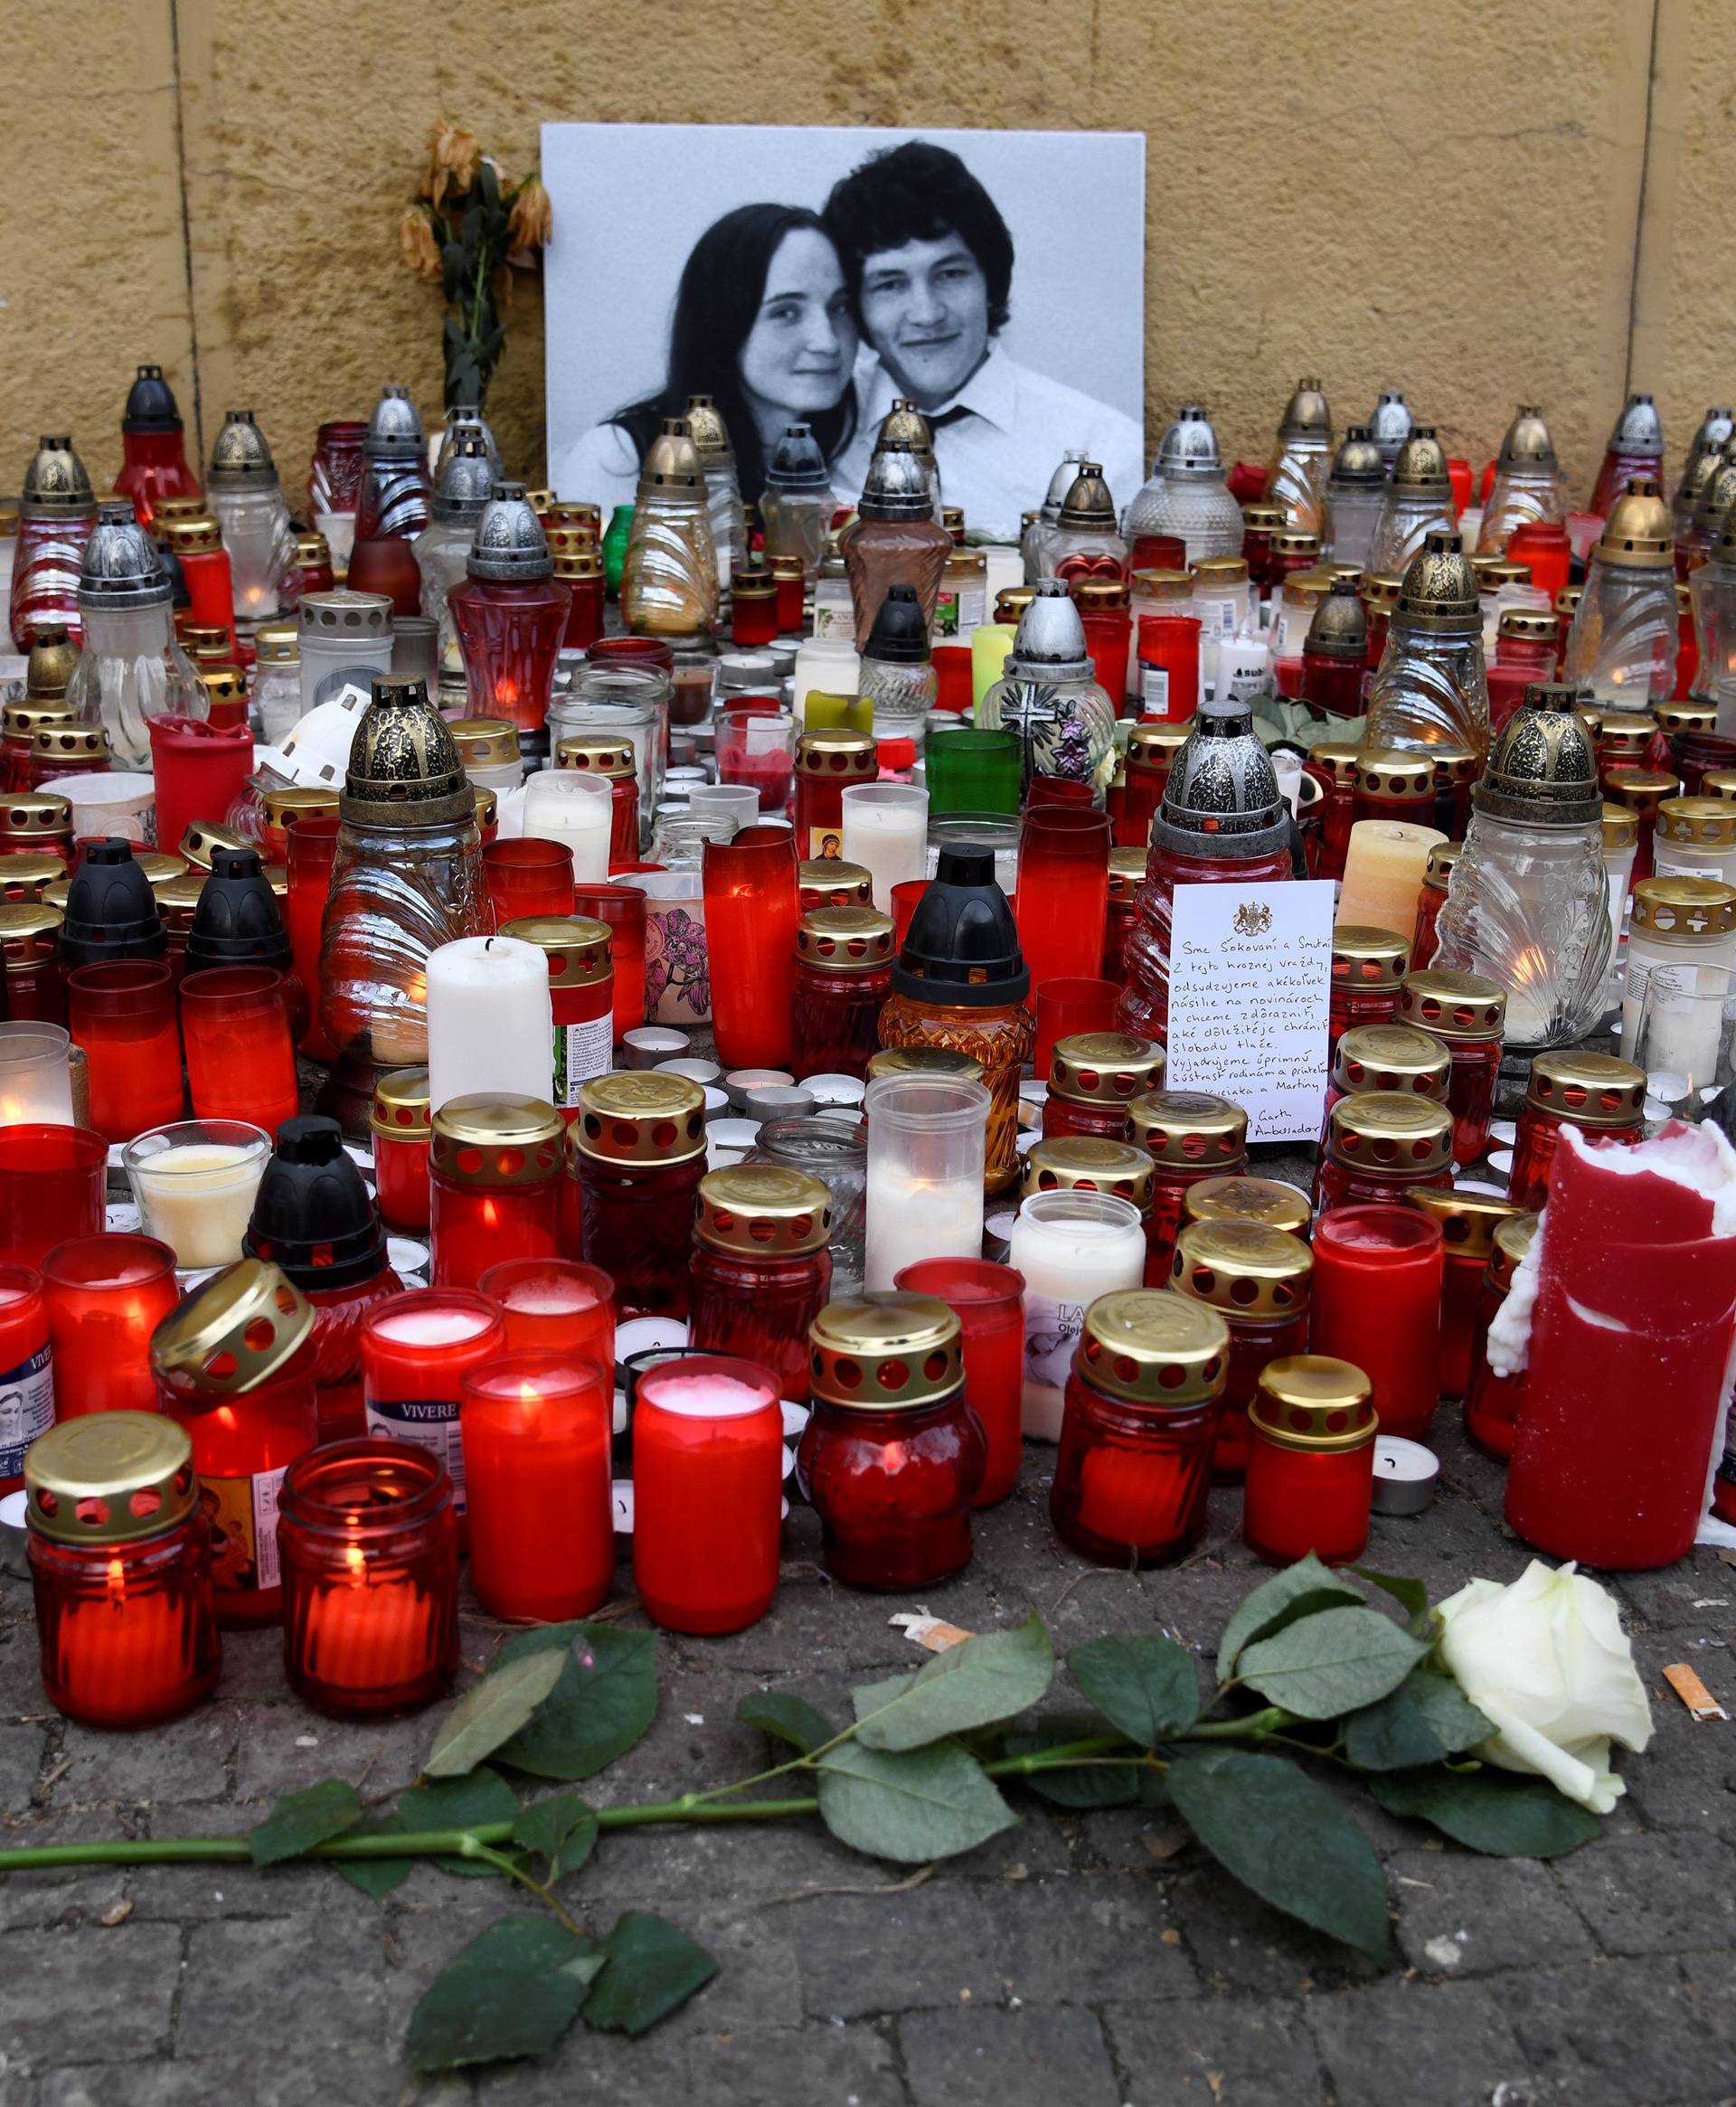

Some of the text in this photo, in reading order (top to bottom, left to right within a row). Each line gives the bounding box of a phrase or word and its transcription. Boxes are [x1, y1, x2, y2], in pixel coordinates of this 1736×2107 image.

[1182, 940, 1211, 955] Sme
[1191, 960, 1219, 975] tejto
[1226, 959, 1273, 973] hroznej
[1171, 996, 1219, 1009] násilie
[1186, 1013, 1231, 1023] chceme
[1172, 1026, 1196, 1039] aké
[1172, 1050, 1312, 1072] Vyjadrujeme úprimnú
[1229, 1066, 1275, 1079] rodinám
[1276, 1078, 1319, 1092] Martiny
[401, 1403, 458, 1419] VIVERE
